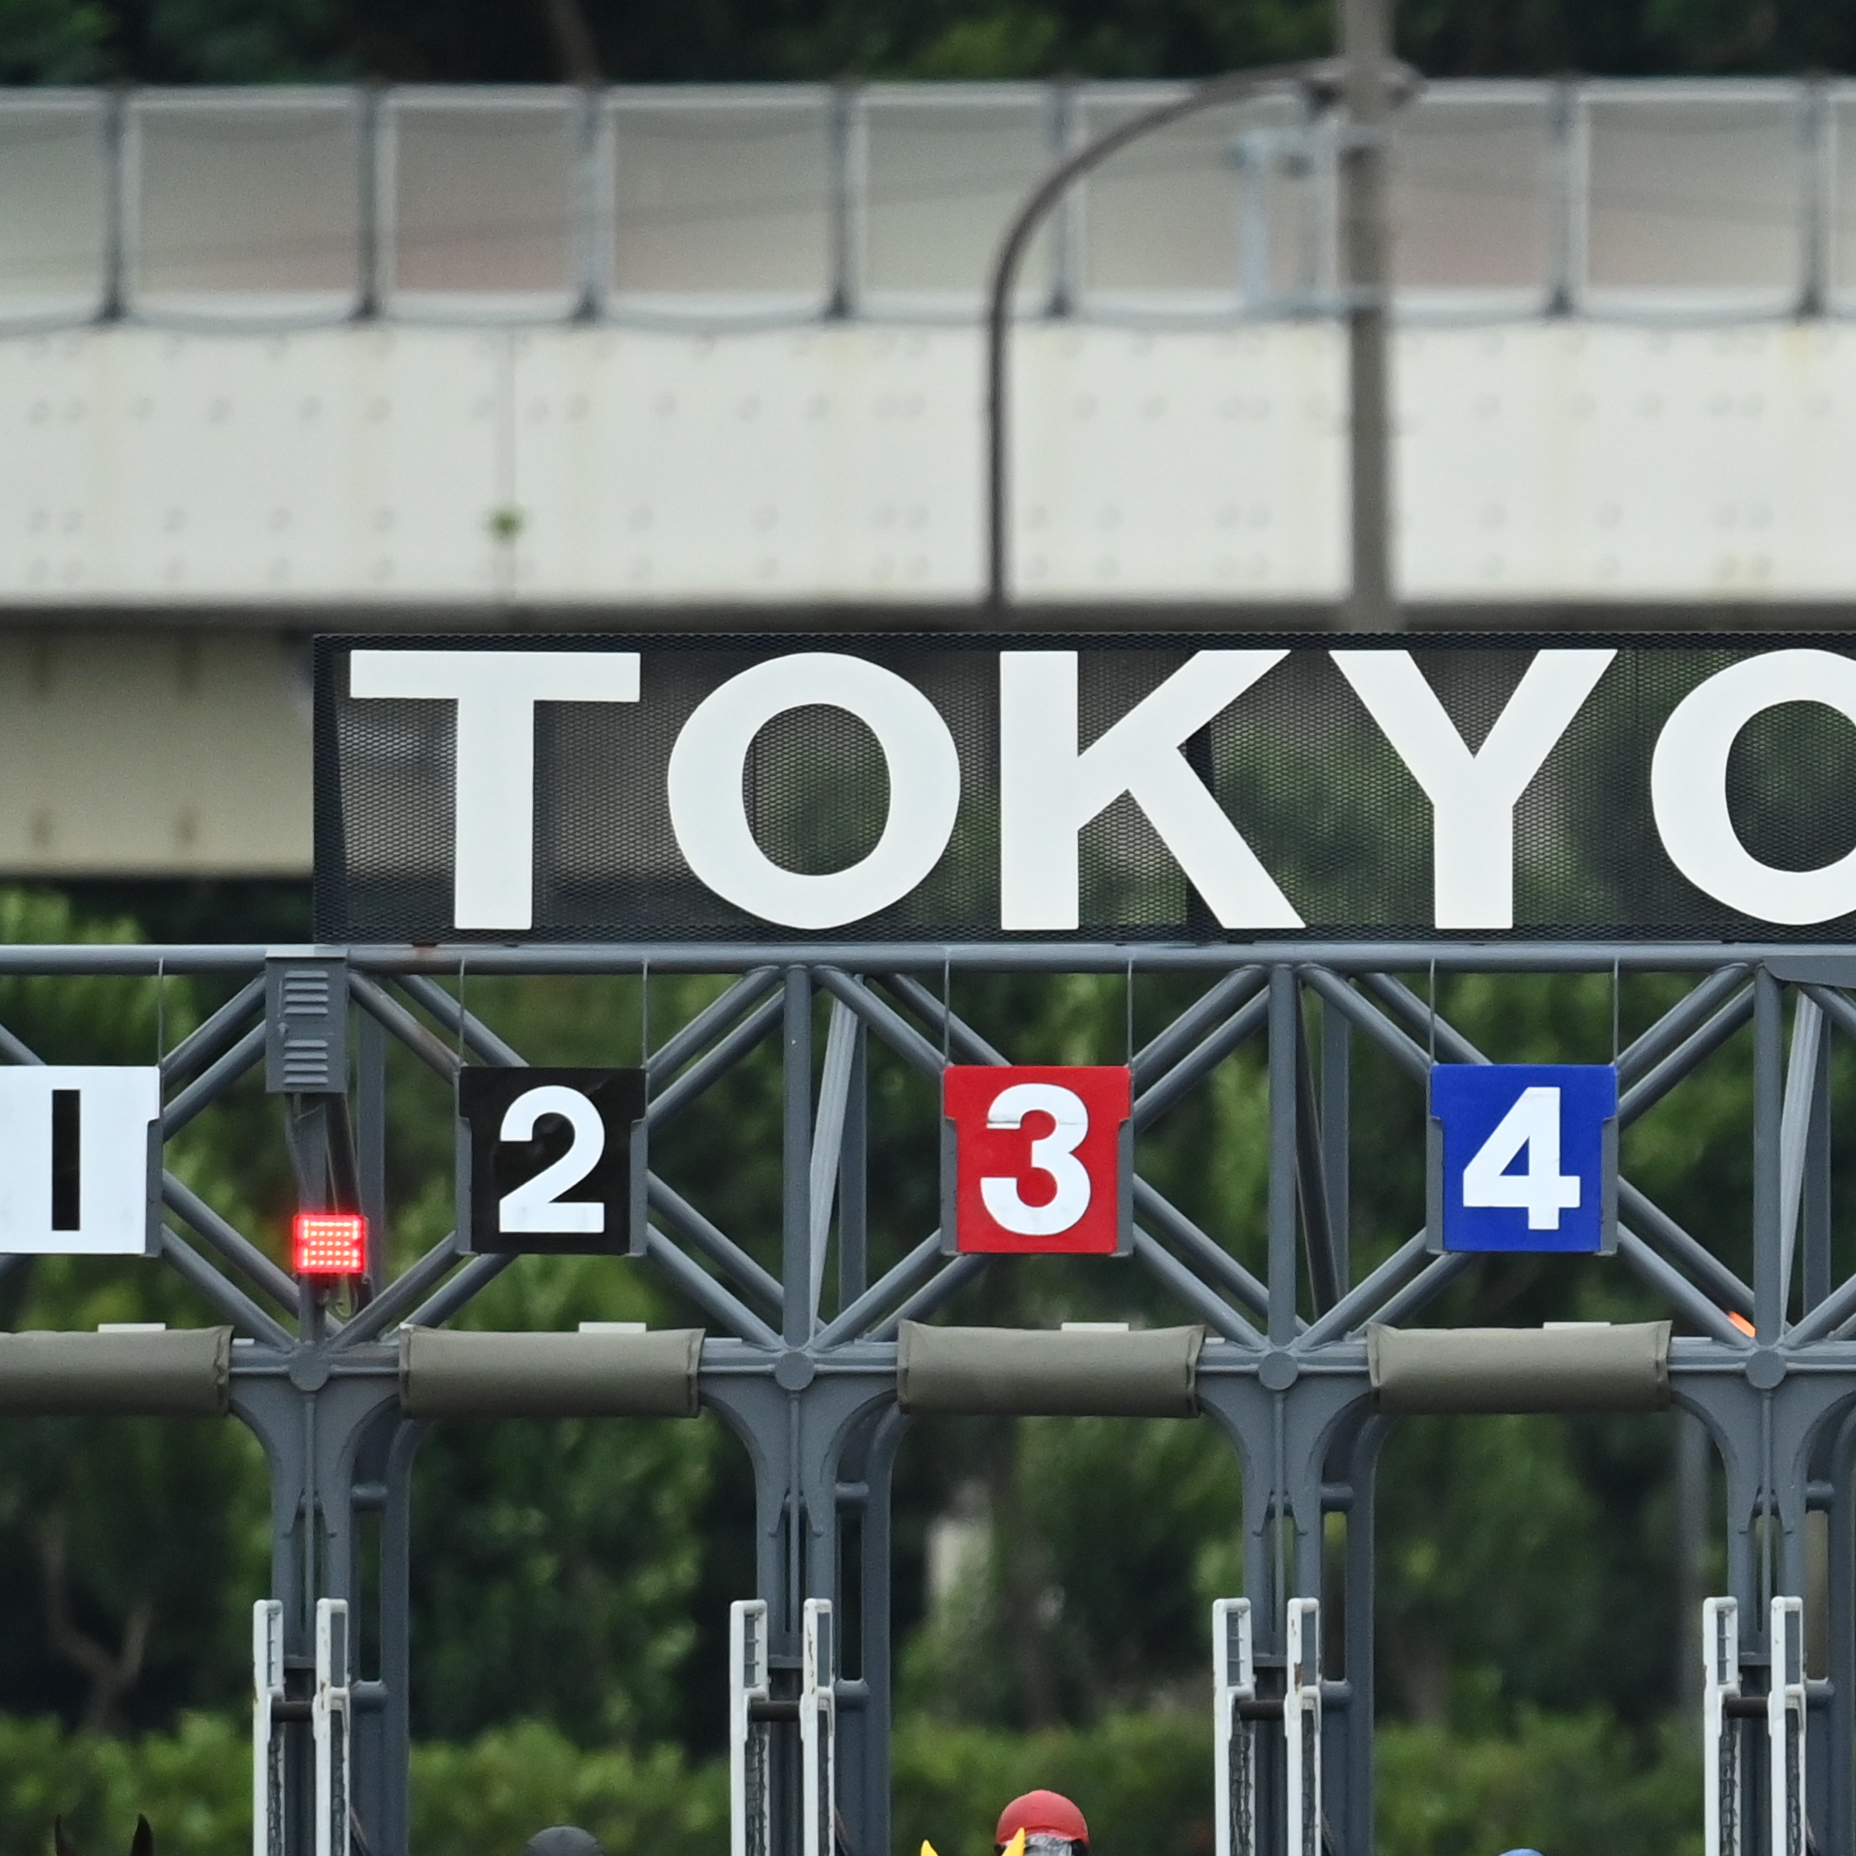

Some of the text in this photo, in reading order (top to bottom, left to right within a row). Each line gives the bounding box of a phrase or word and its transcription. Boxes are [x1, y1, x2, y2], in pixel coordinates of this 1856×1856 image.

[52, 1089, 80, 1231] 1
[499, 1085, 605, 1233] 2
[980, 1083, 1091, 1236] 3
[1464, 1087, 1580, 1230] 4
